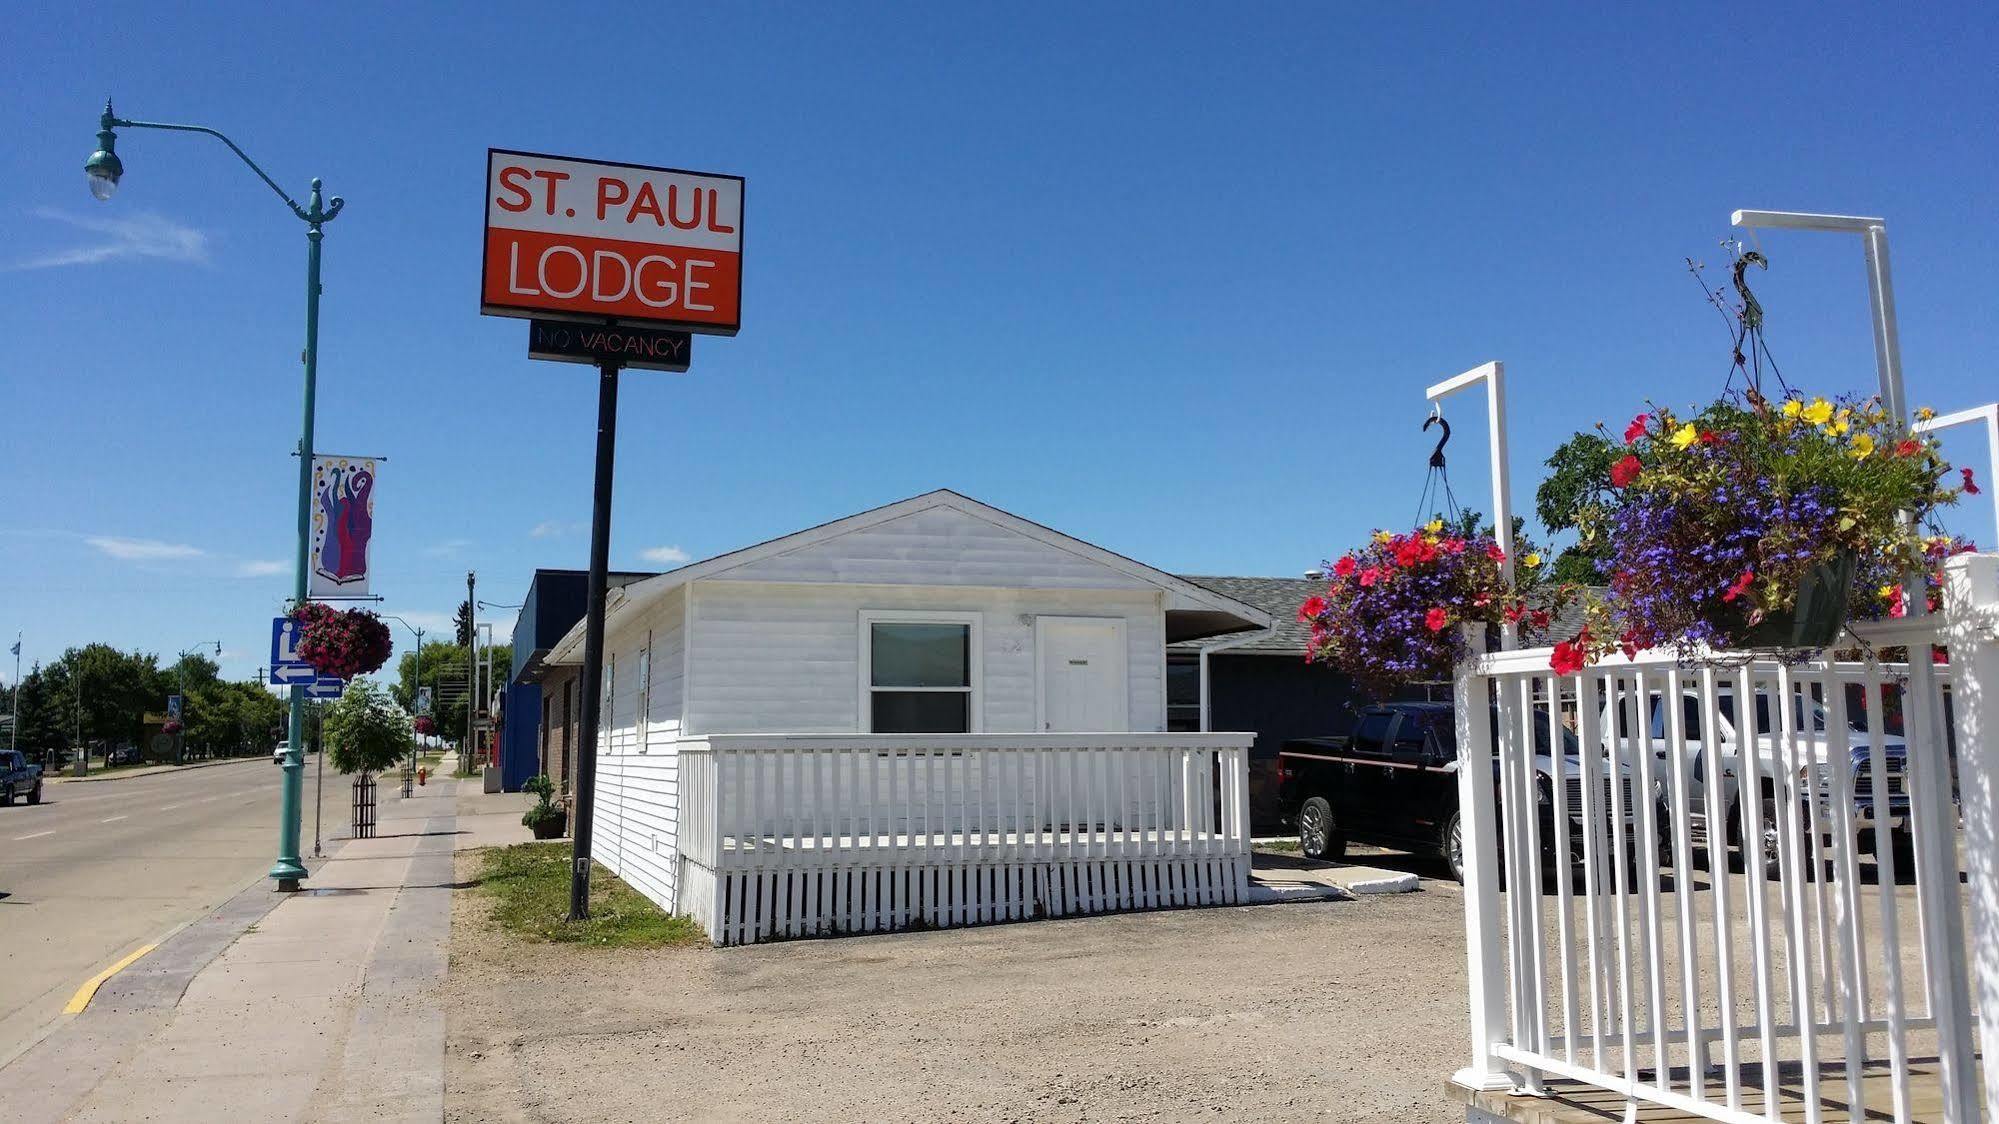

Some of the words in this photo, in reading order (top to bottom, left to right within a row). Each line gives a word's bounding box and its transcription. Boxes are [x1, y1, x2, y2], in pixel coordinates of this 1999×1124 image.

[496, 166, 576, 218] ST.
[597, 177, 734, 234] PAUL
[509, 241, 716, 312] LODGE
[538, 327, 570, 348] NO
[580, 330, 684, 359] VACANCY
